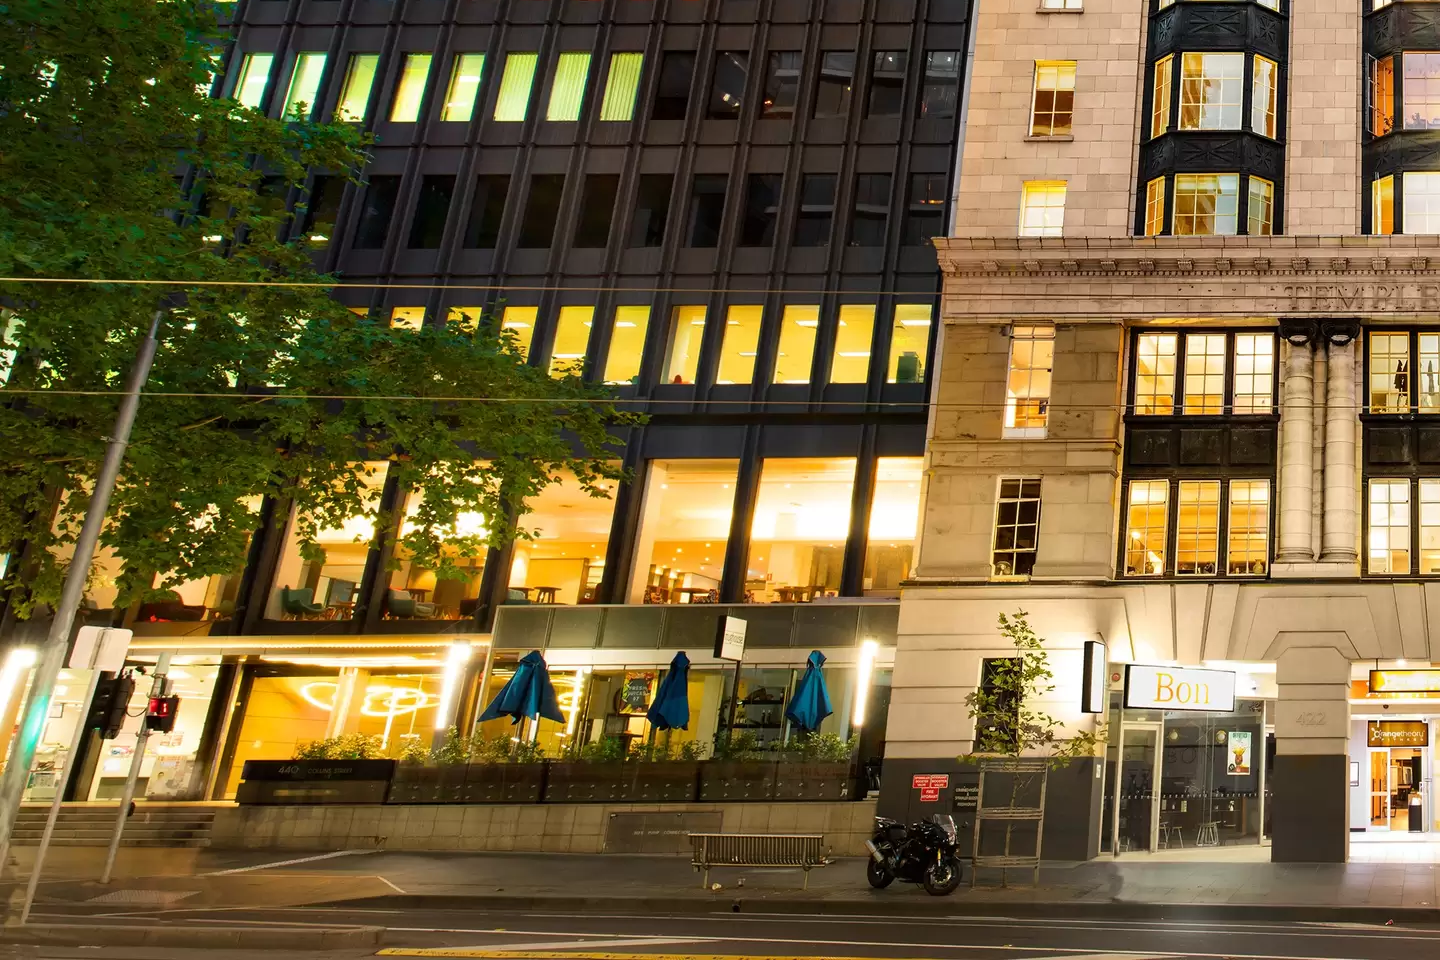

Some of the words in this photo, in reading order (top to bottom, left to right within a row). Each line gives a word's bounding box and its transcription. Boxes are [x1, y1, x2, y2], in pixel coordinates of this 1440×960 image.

[1284, 286, 1440, 310] TEMPLE
[1154, 673, 1210, 705] Bon
[1295, 711, 1326, 726] 422
[278, 766, 300, 774] 440
